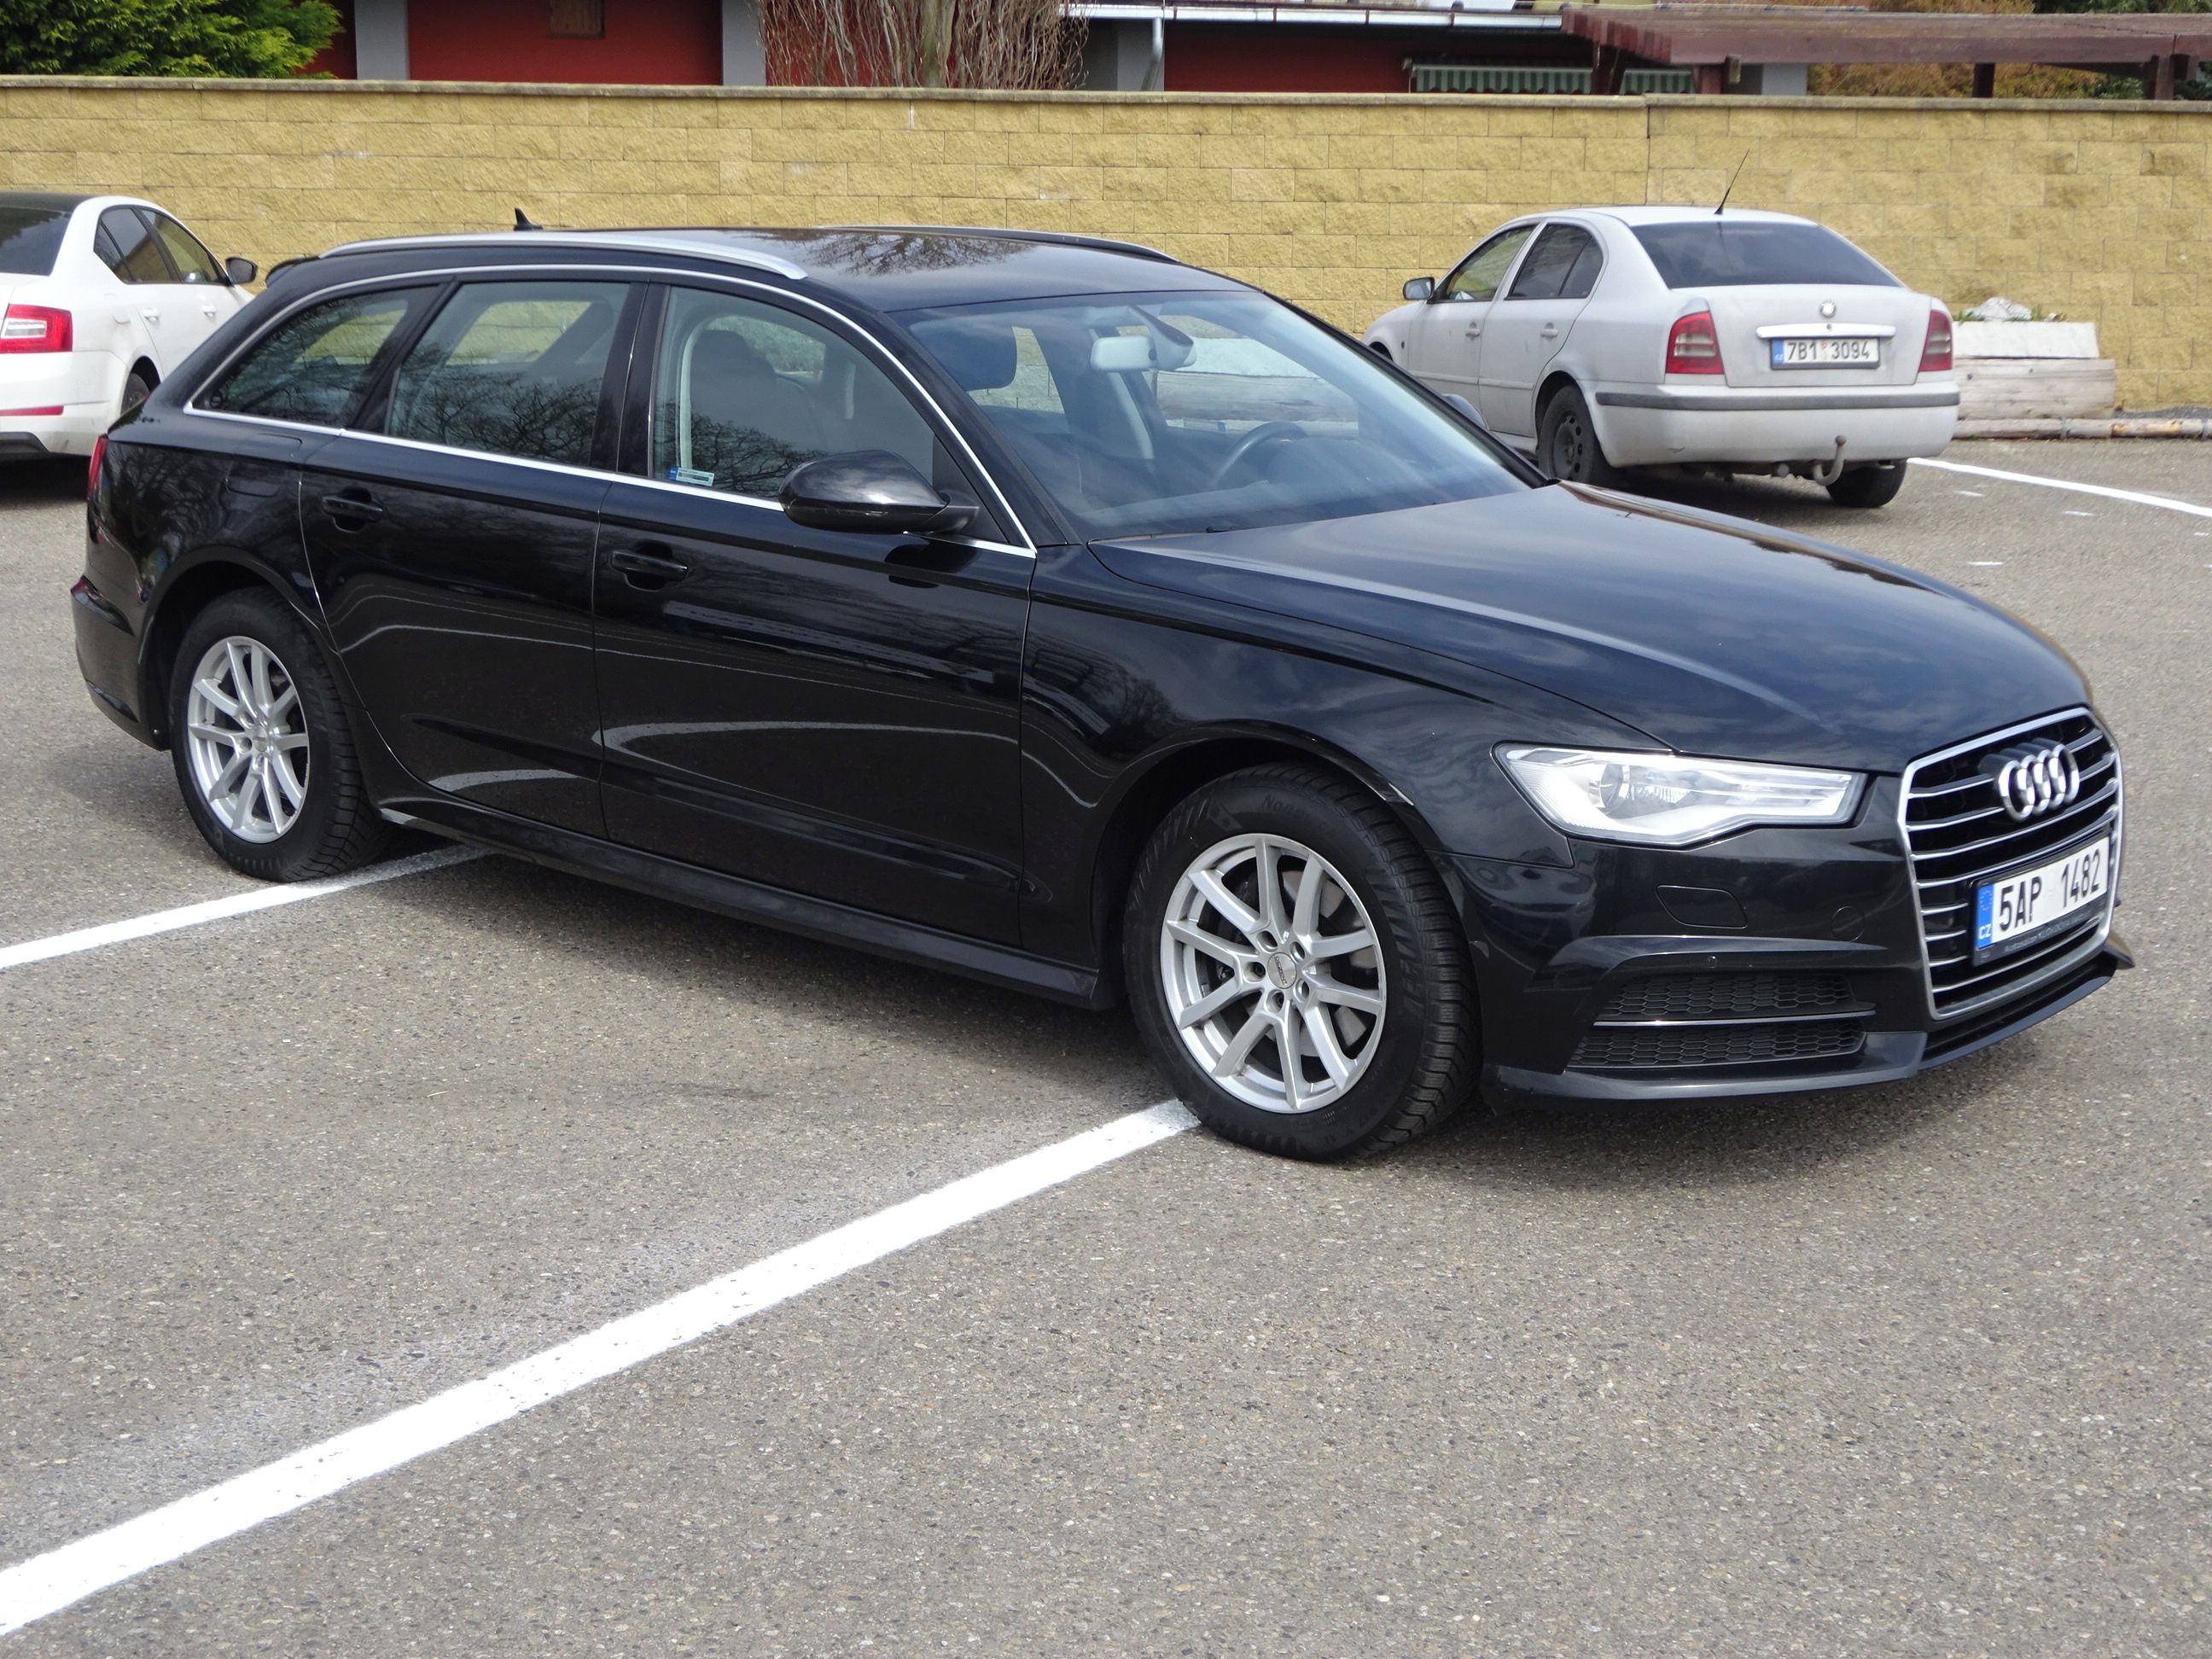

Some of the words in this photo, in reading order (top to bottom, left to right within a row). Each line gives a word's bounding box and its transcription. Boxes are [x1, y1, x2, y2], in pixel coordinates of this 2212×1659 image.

[1788, 342, 1817, 360] 7B1
[1831, 341, 1870, 359] 3094
[1979, 923, 1992, 940] CZ
[1999, 876, 2042, 932] 5AP
[2061, 848, 2101, 909] 1482
